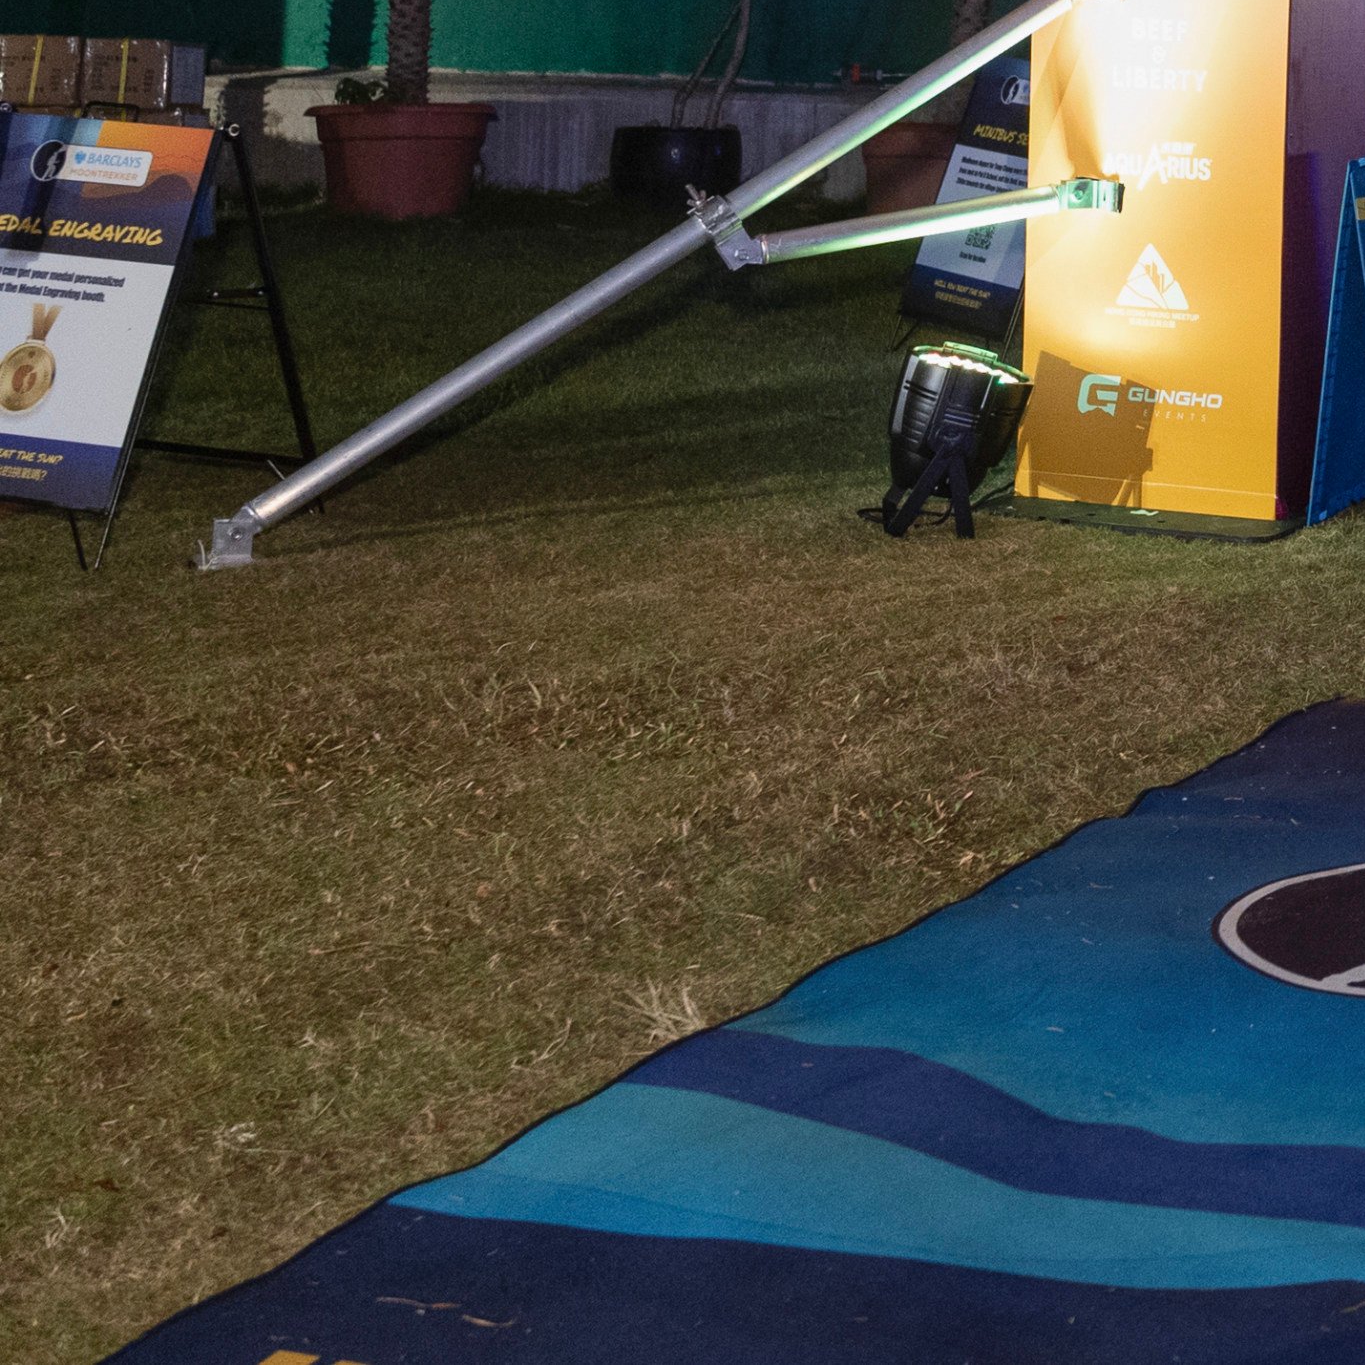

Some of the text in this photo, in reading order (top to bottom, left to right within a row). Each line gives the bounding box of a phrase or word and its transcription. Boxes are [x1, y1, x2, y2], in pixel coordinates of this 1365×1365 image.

[87, 153, 142, 168] BARCLAYS
[1102, 143, 1213, 192] AQUARIUS
[70, 167, 139, 181] MOONTREKKER
[0, 213, 164, 246] EDAL ENGRAVING
[1127, 387, 1223, 409] GUNGHO
[1143, 409, 1206, 423] EVENTS
